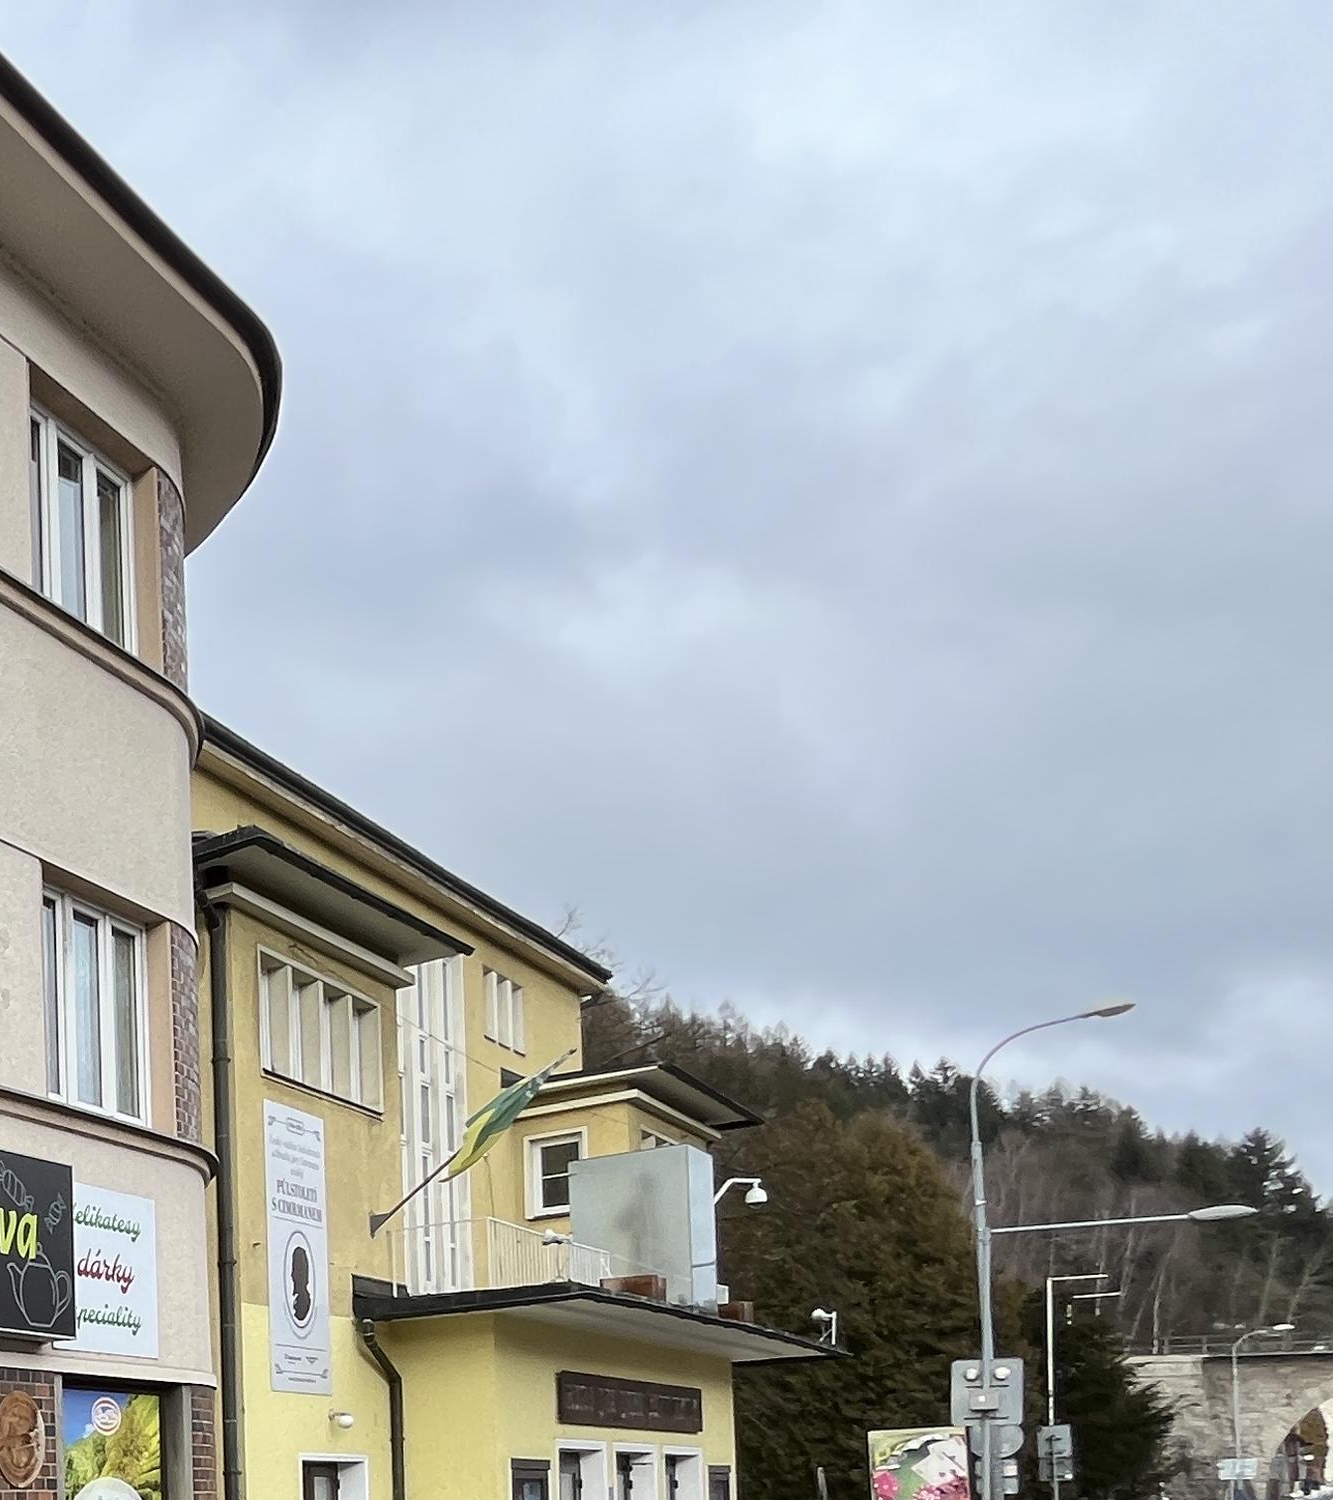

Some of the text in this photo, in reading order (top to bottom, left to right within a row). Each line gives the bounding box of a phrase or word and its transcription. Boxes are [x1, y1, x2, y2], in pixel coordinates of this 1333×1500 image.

[73, 1203, 142, 1242] elikatesy
[77, 1248, 135, 1295] dárky
[76, 1304, 142, 1337] peciality
